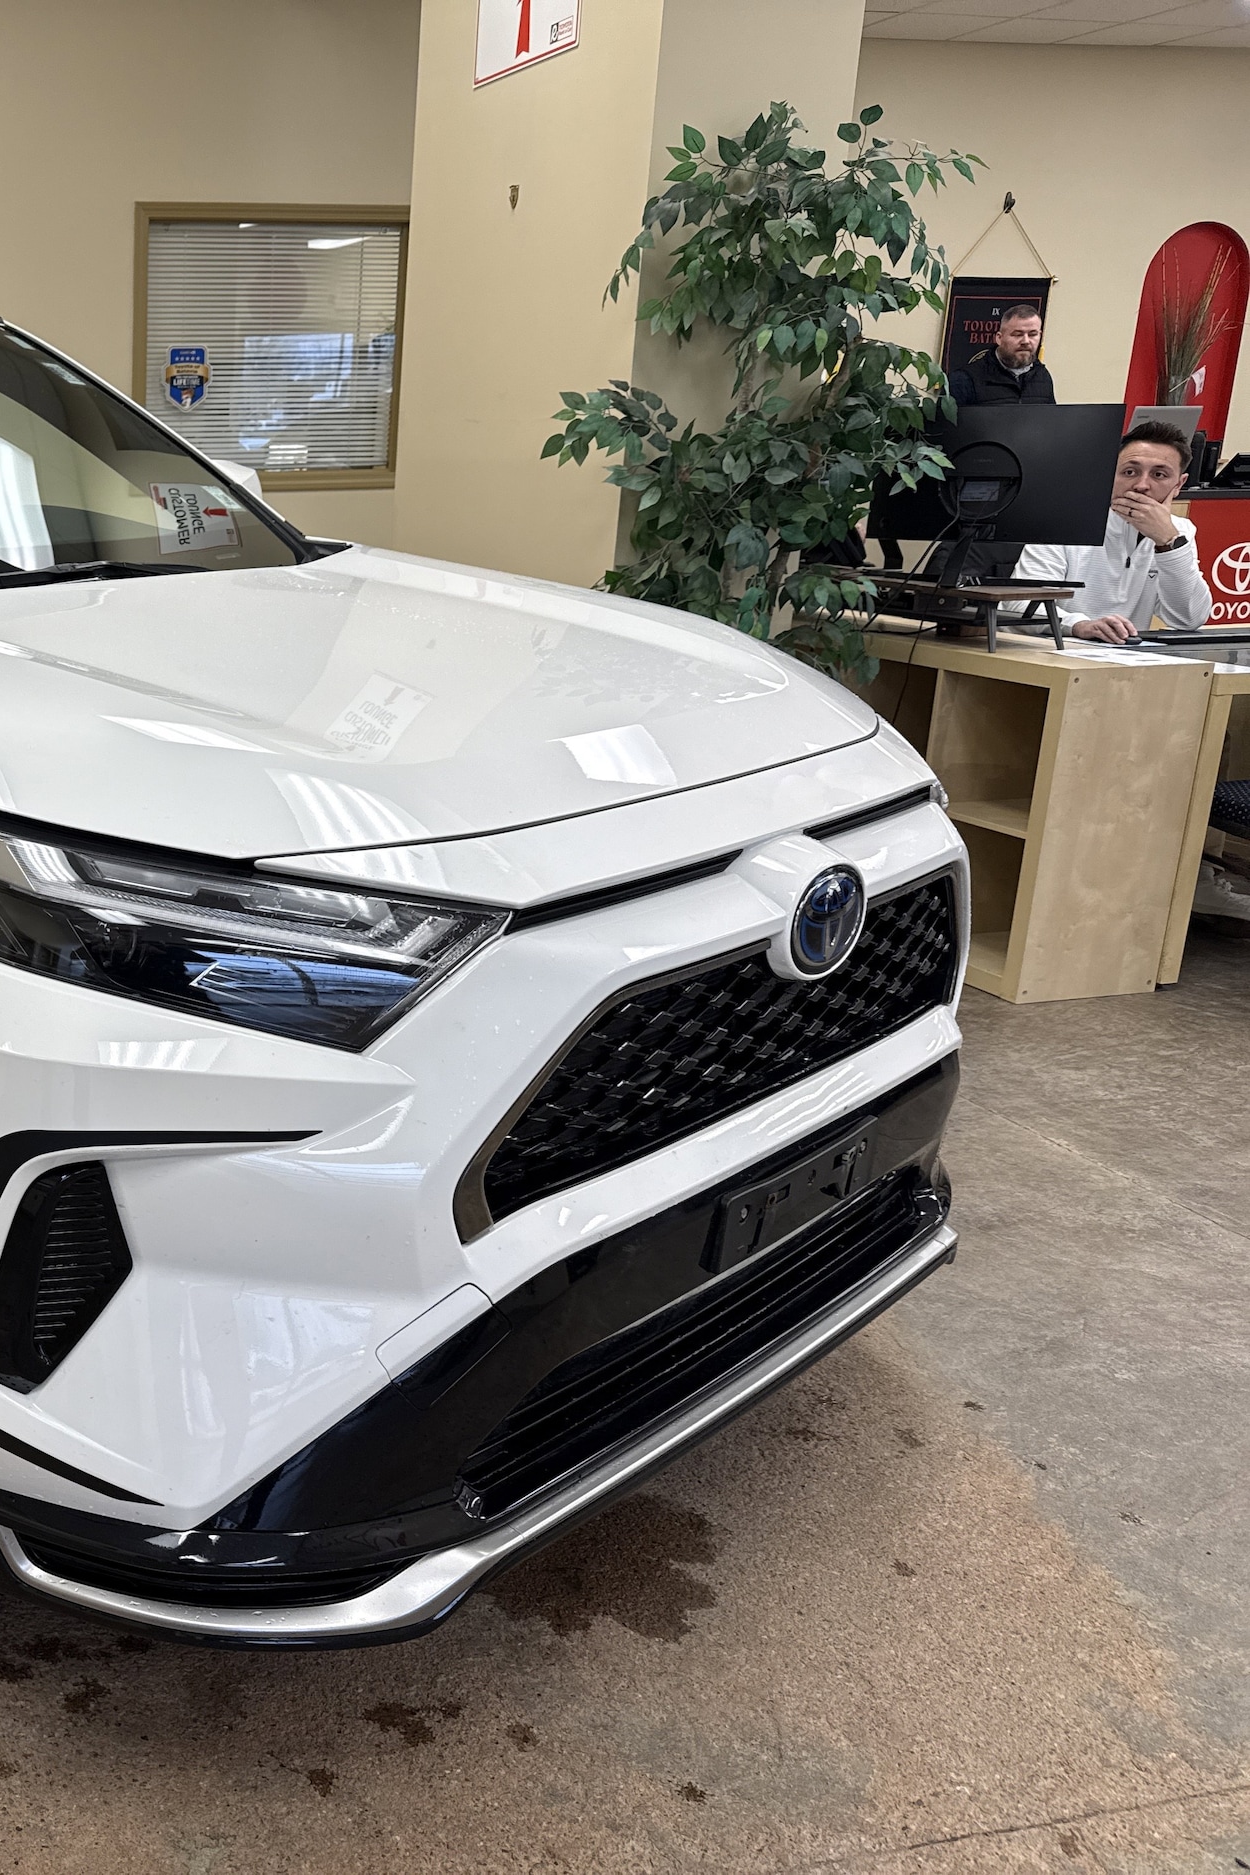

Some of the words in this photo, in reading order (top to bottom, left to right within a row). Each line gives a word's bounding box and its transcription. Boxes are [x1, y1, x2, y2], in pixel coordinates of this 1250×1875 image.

[963, 320, 1000, 332] TOYOT
[969, 332, 997, 344] BAT
[1210, 601, 1250, 620] OYO
